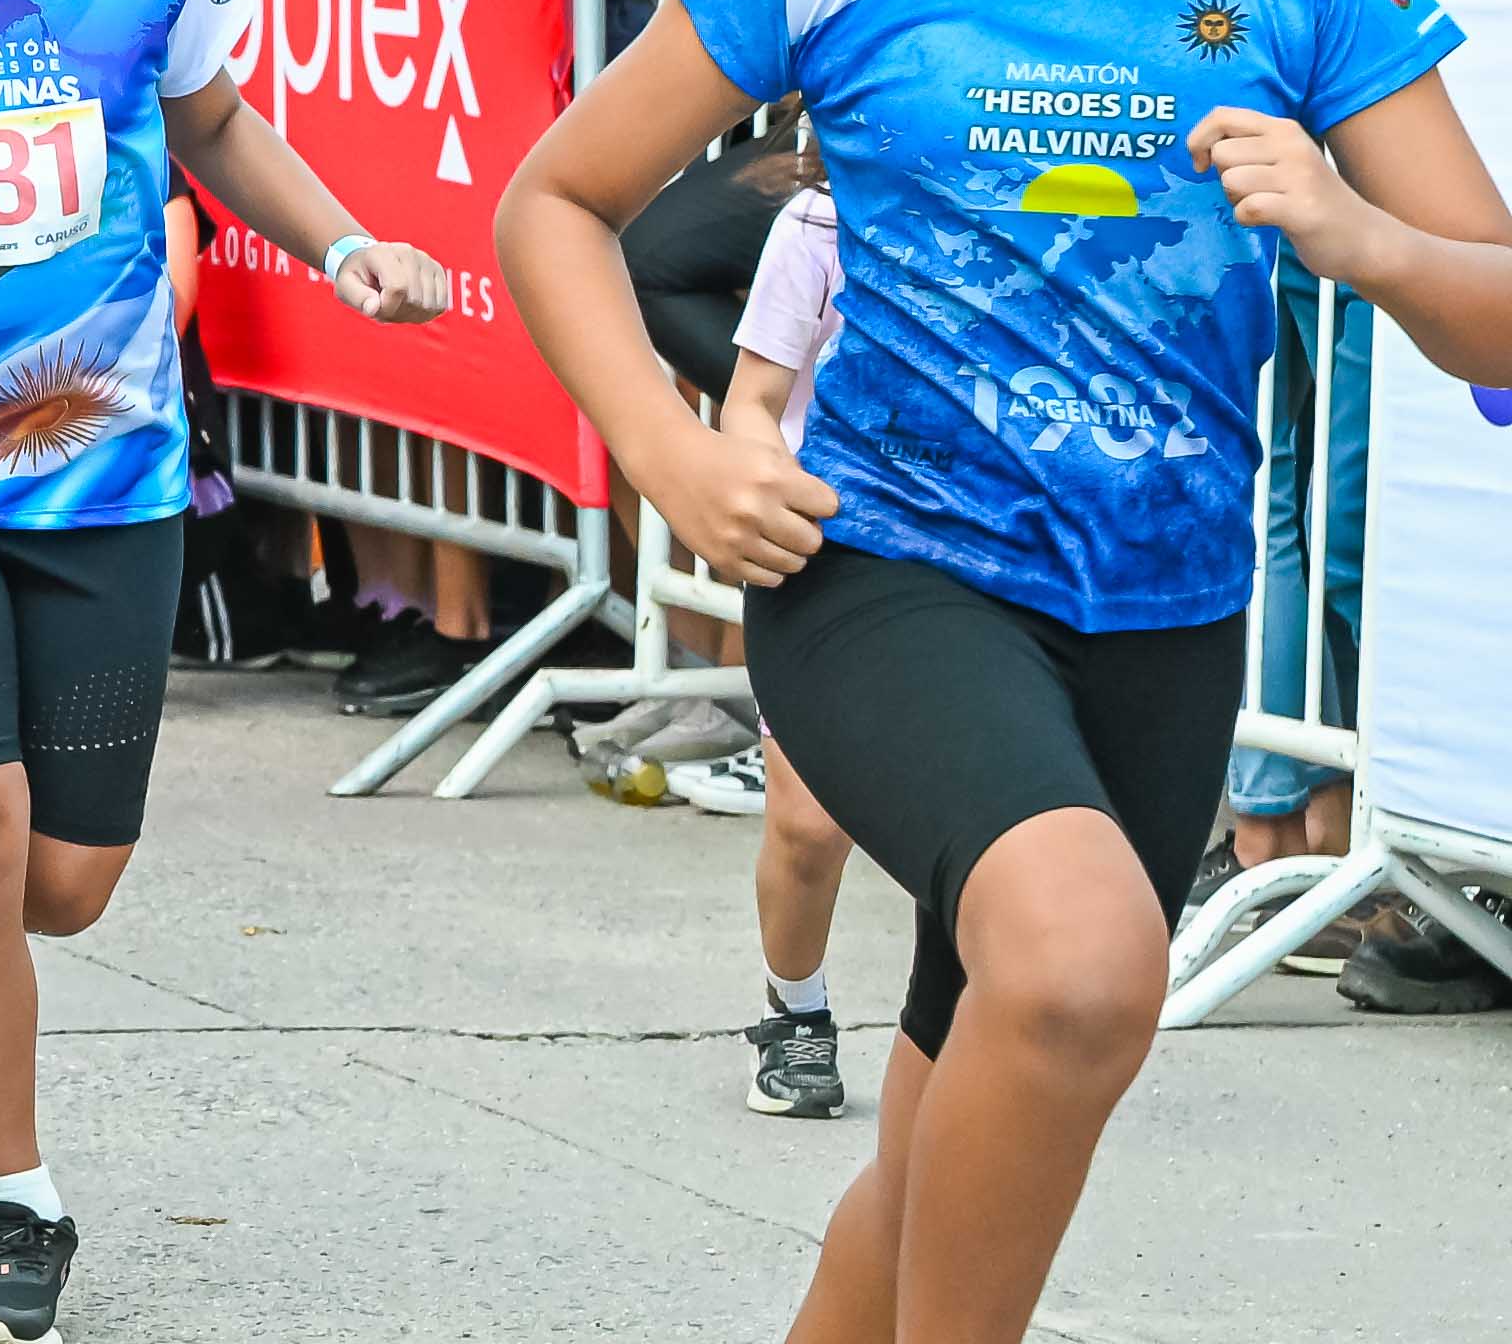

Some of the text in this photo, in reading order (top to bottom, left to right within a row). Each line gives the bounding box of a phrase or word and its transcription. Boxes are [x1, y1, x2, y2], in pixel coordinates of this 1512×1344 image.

[31, 58, 61, 72] DE
[1005, 61, 1140, 85] MARATÓN
[1129, 94, 1176, 121] DE
[34, 221, 89, 247] CARUSO
